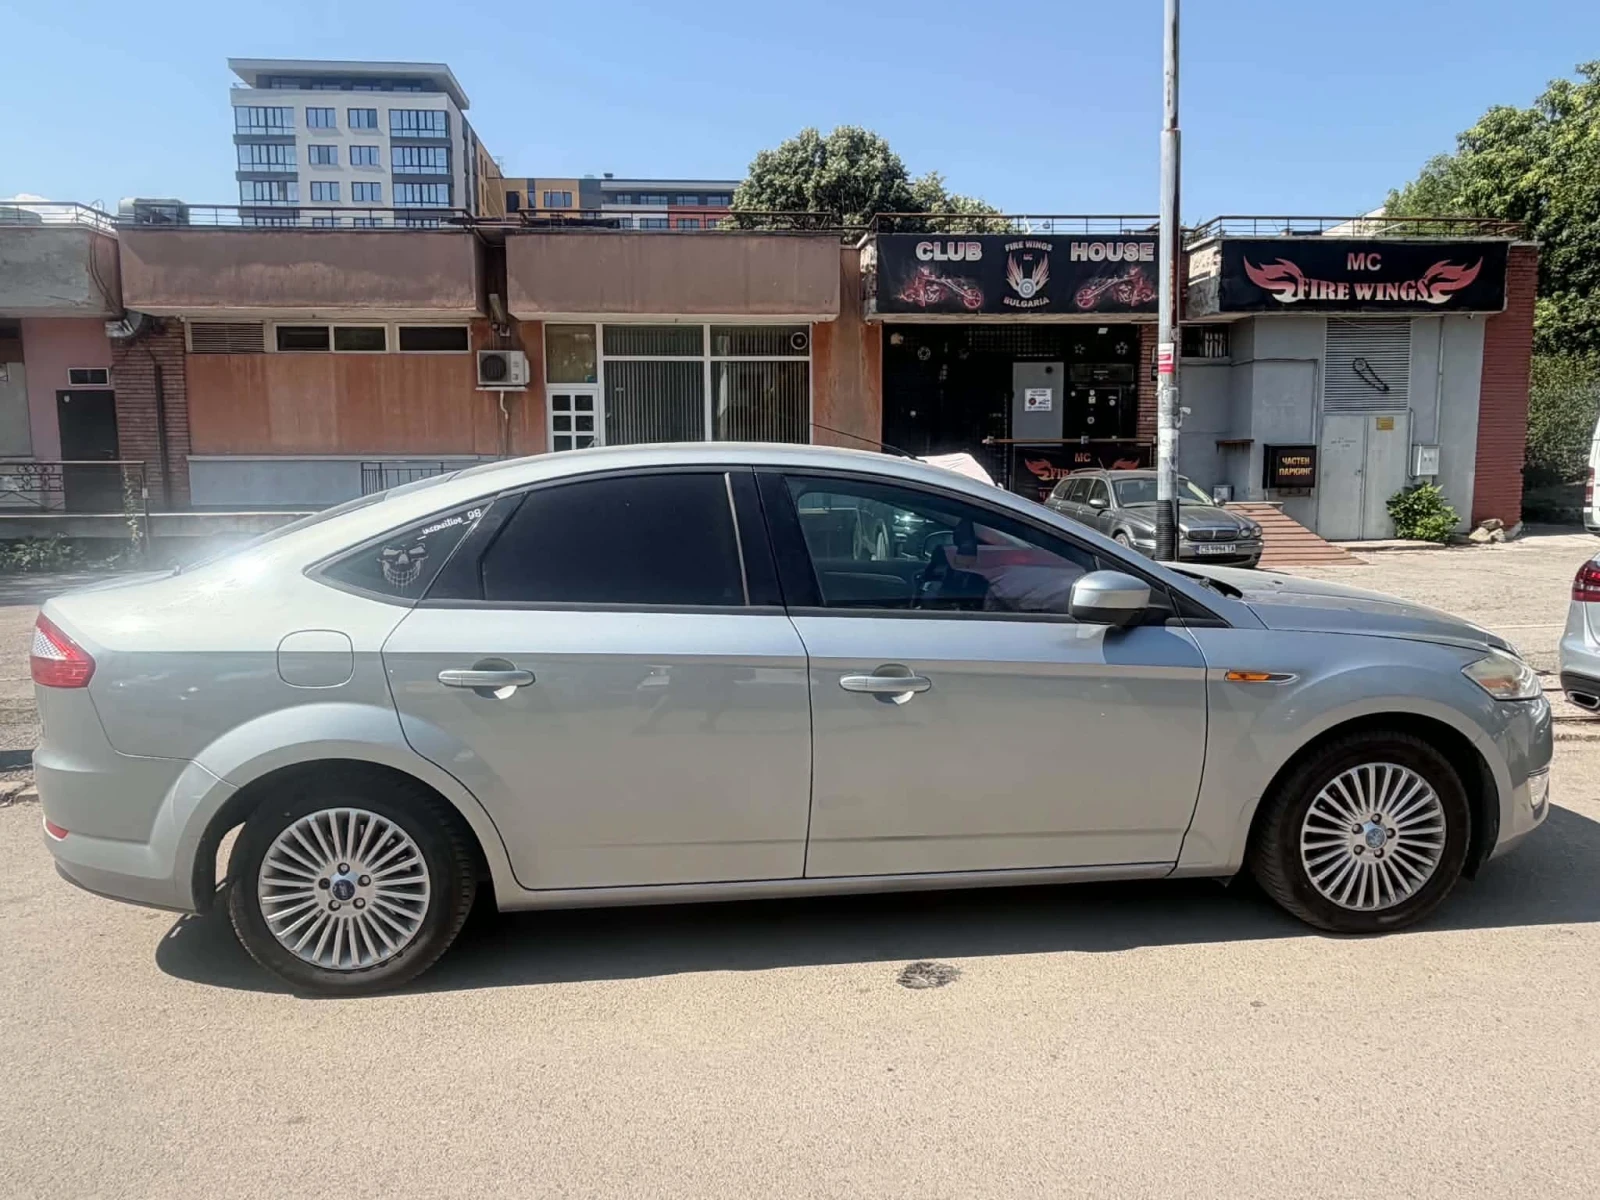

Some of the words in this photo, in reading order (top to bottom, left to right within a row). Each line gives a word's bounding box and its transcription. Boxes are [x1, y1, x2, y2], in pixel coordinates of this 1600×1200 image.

[915, 241, 983, 262] CLUB
[1070, 241, 1155, 262] HOUSE
[1004, 241, 1024, 252] FIRE
[1025, 240, 1053, 252] WINGS
[1346, 253, 1382, 271] MC
[1299, 277, 1350, 300] FIRE
[1353, 279, 1430, 301] WINGS
[1003, 296, 1050, 308] BULGARIA
[1074, 452, 1091, 463] MC
[1281, 456, 1310, 465] ЧАСТЕН
[1050, 467, 1073, 480] FIR
[1279, 467, 1312, 476] ПАРКИНГ
